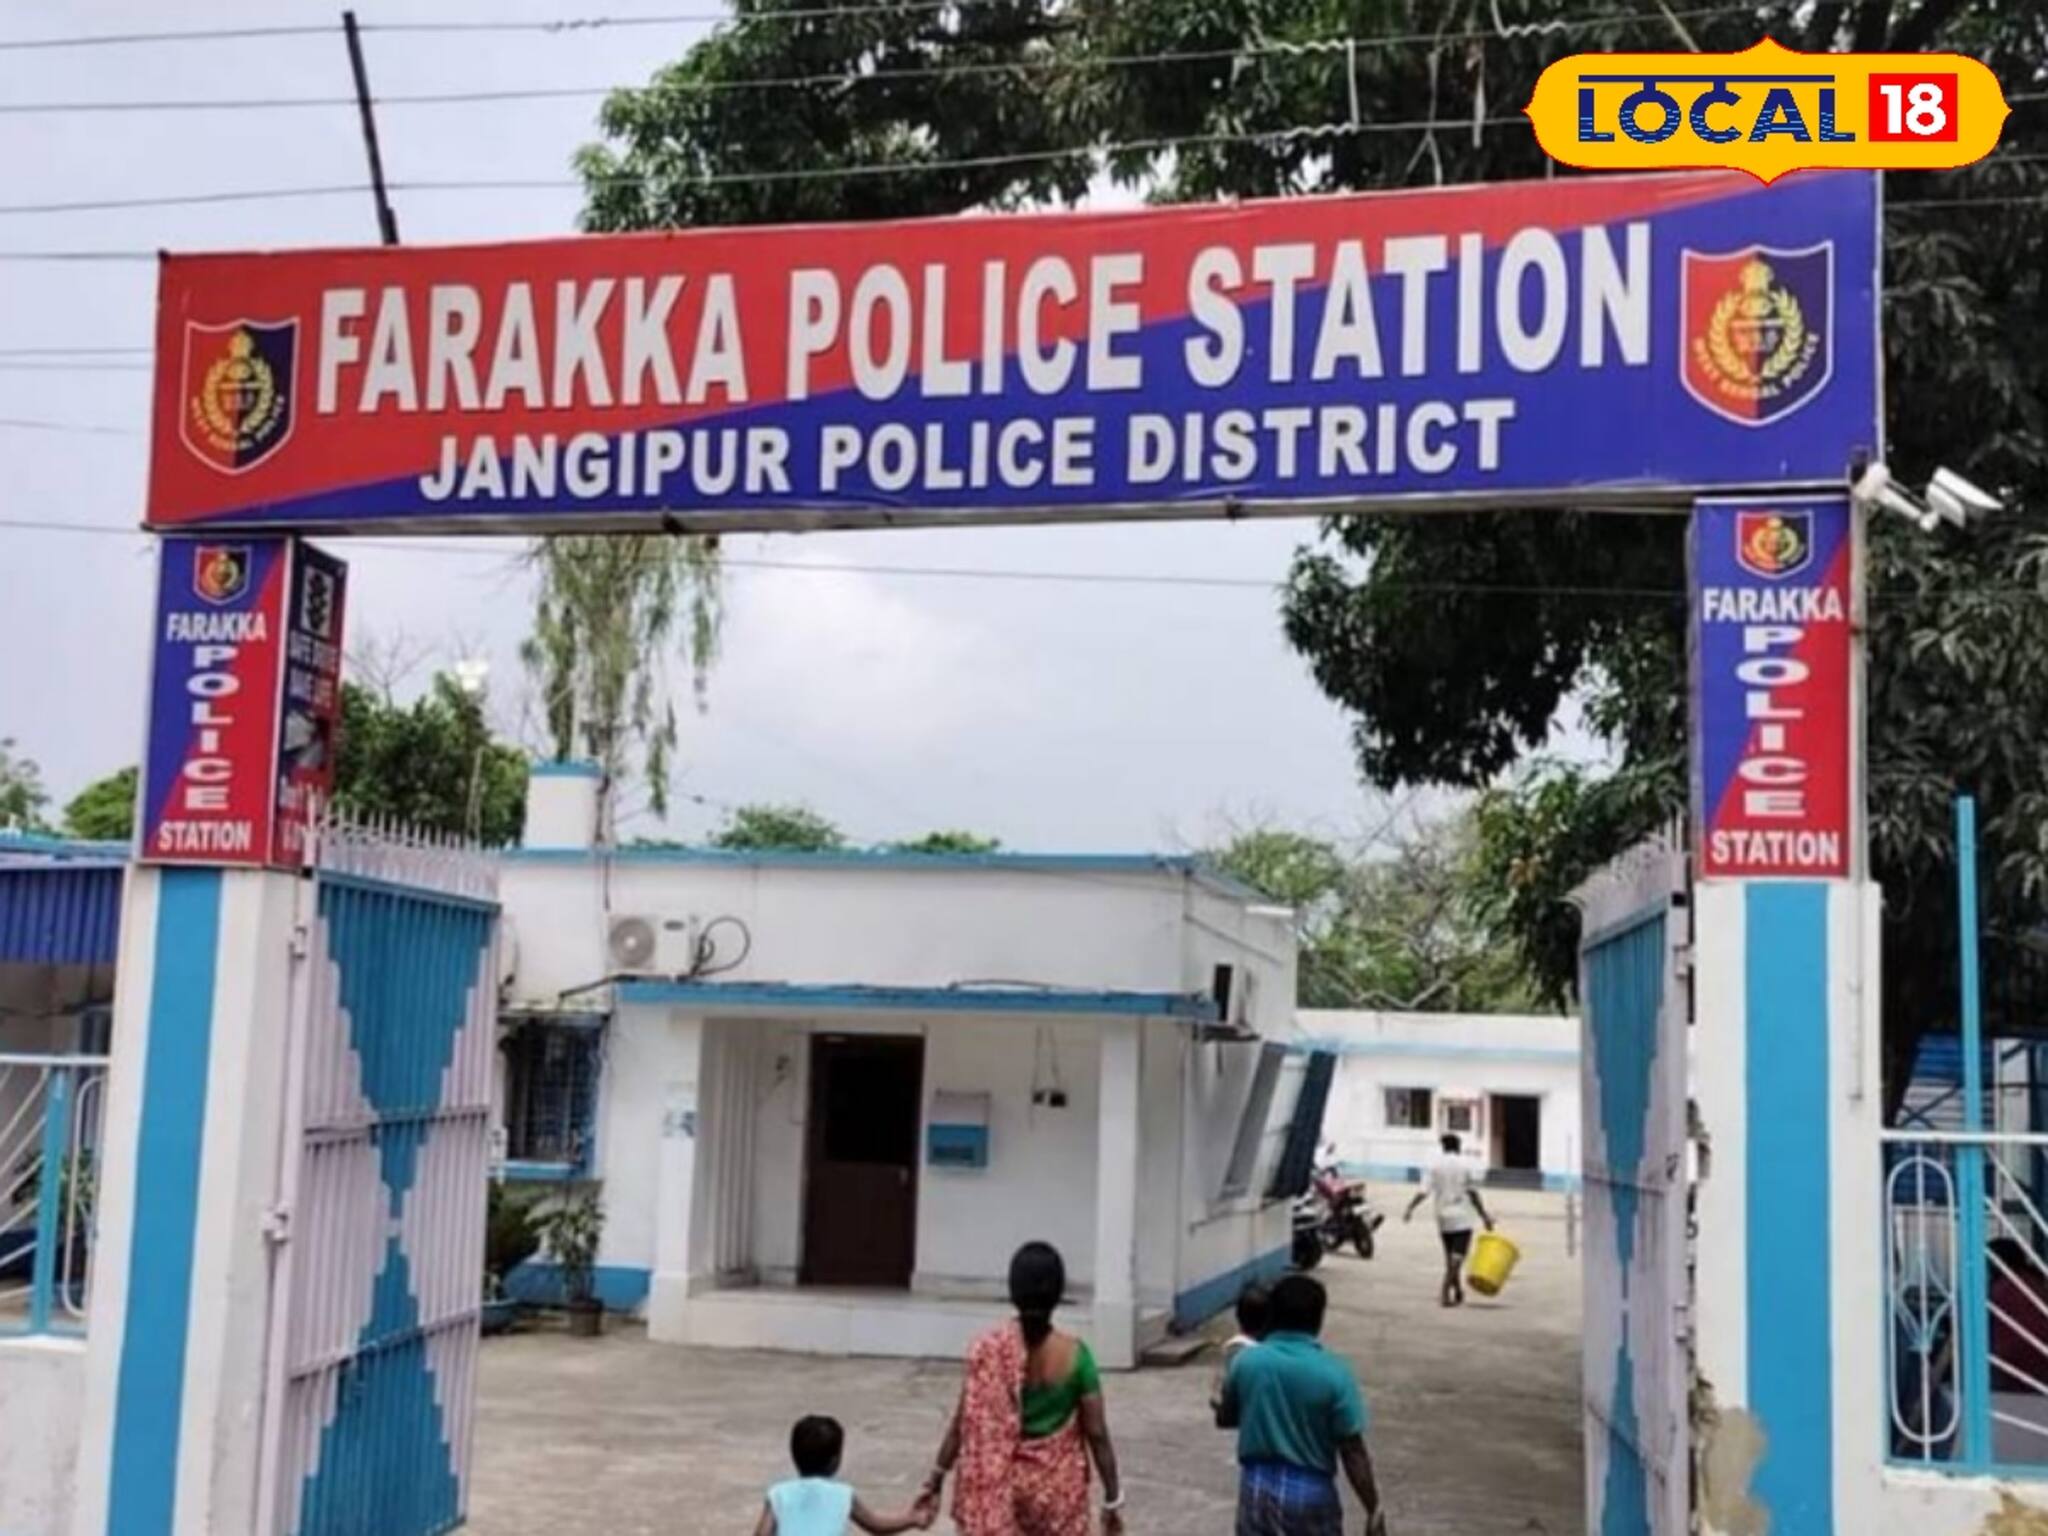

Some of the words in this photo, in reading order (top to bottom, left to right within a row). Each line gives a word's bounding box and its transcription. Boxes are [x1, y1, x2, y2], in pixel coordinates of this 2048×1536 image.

[318, 274, 748, 413] FARAKKA
[787, 253, 1144, 401] POLICE
[1184, 222, 1651, 387] STATION
[420, 428, 791, 501] JANGIPUR
[820, 417, 1095, 490] POLICE
[1127, 399, 1516, 482] DISTRICT
[166, 612, 267, 642] FARAKKA
[1702, 586, 1843, 623] FARAKKA
[181, 645, 240, 810] POLICE
[1735, 625, 1810, 818] POLICE
[158, 821, 252, 851] STATION
[1711, 829, 1840, 866] STATION
